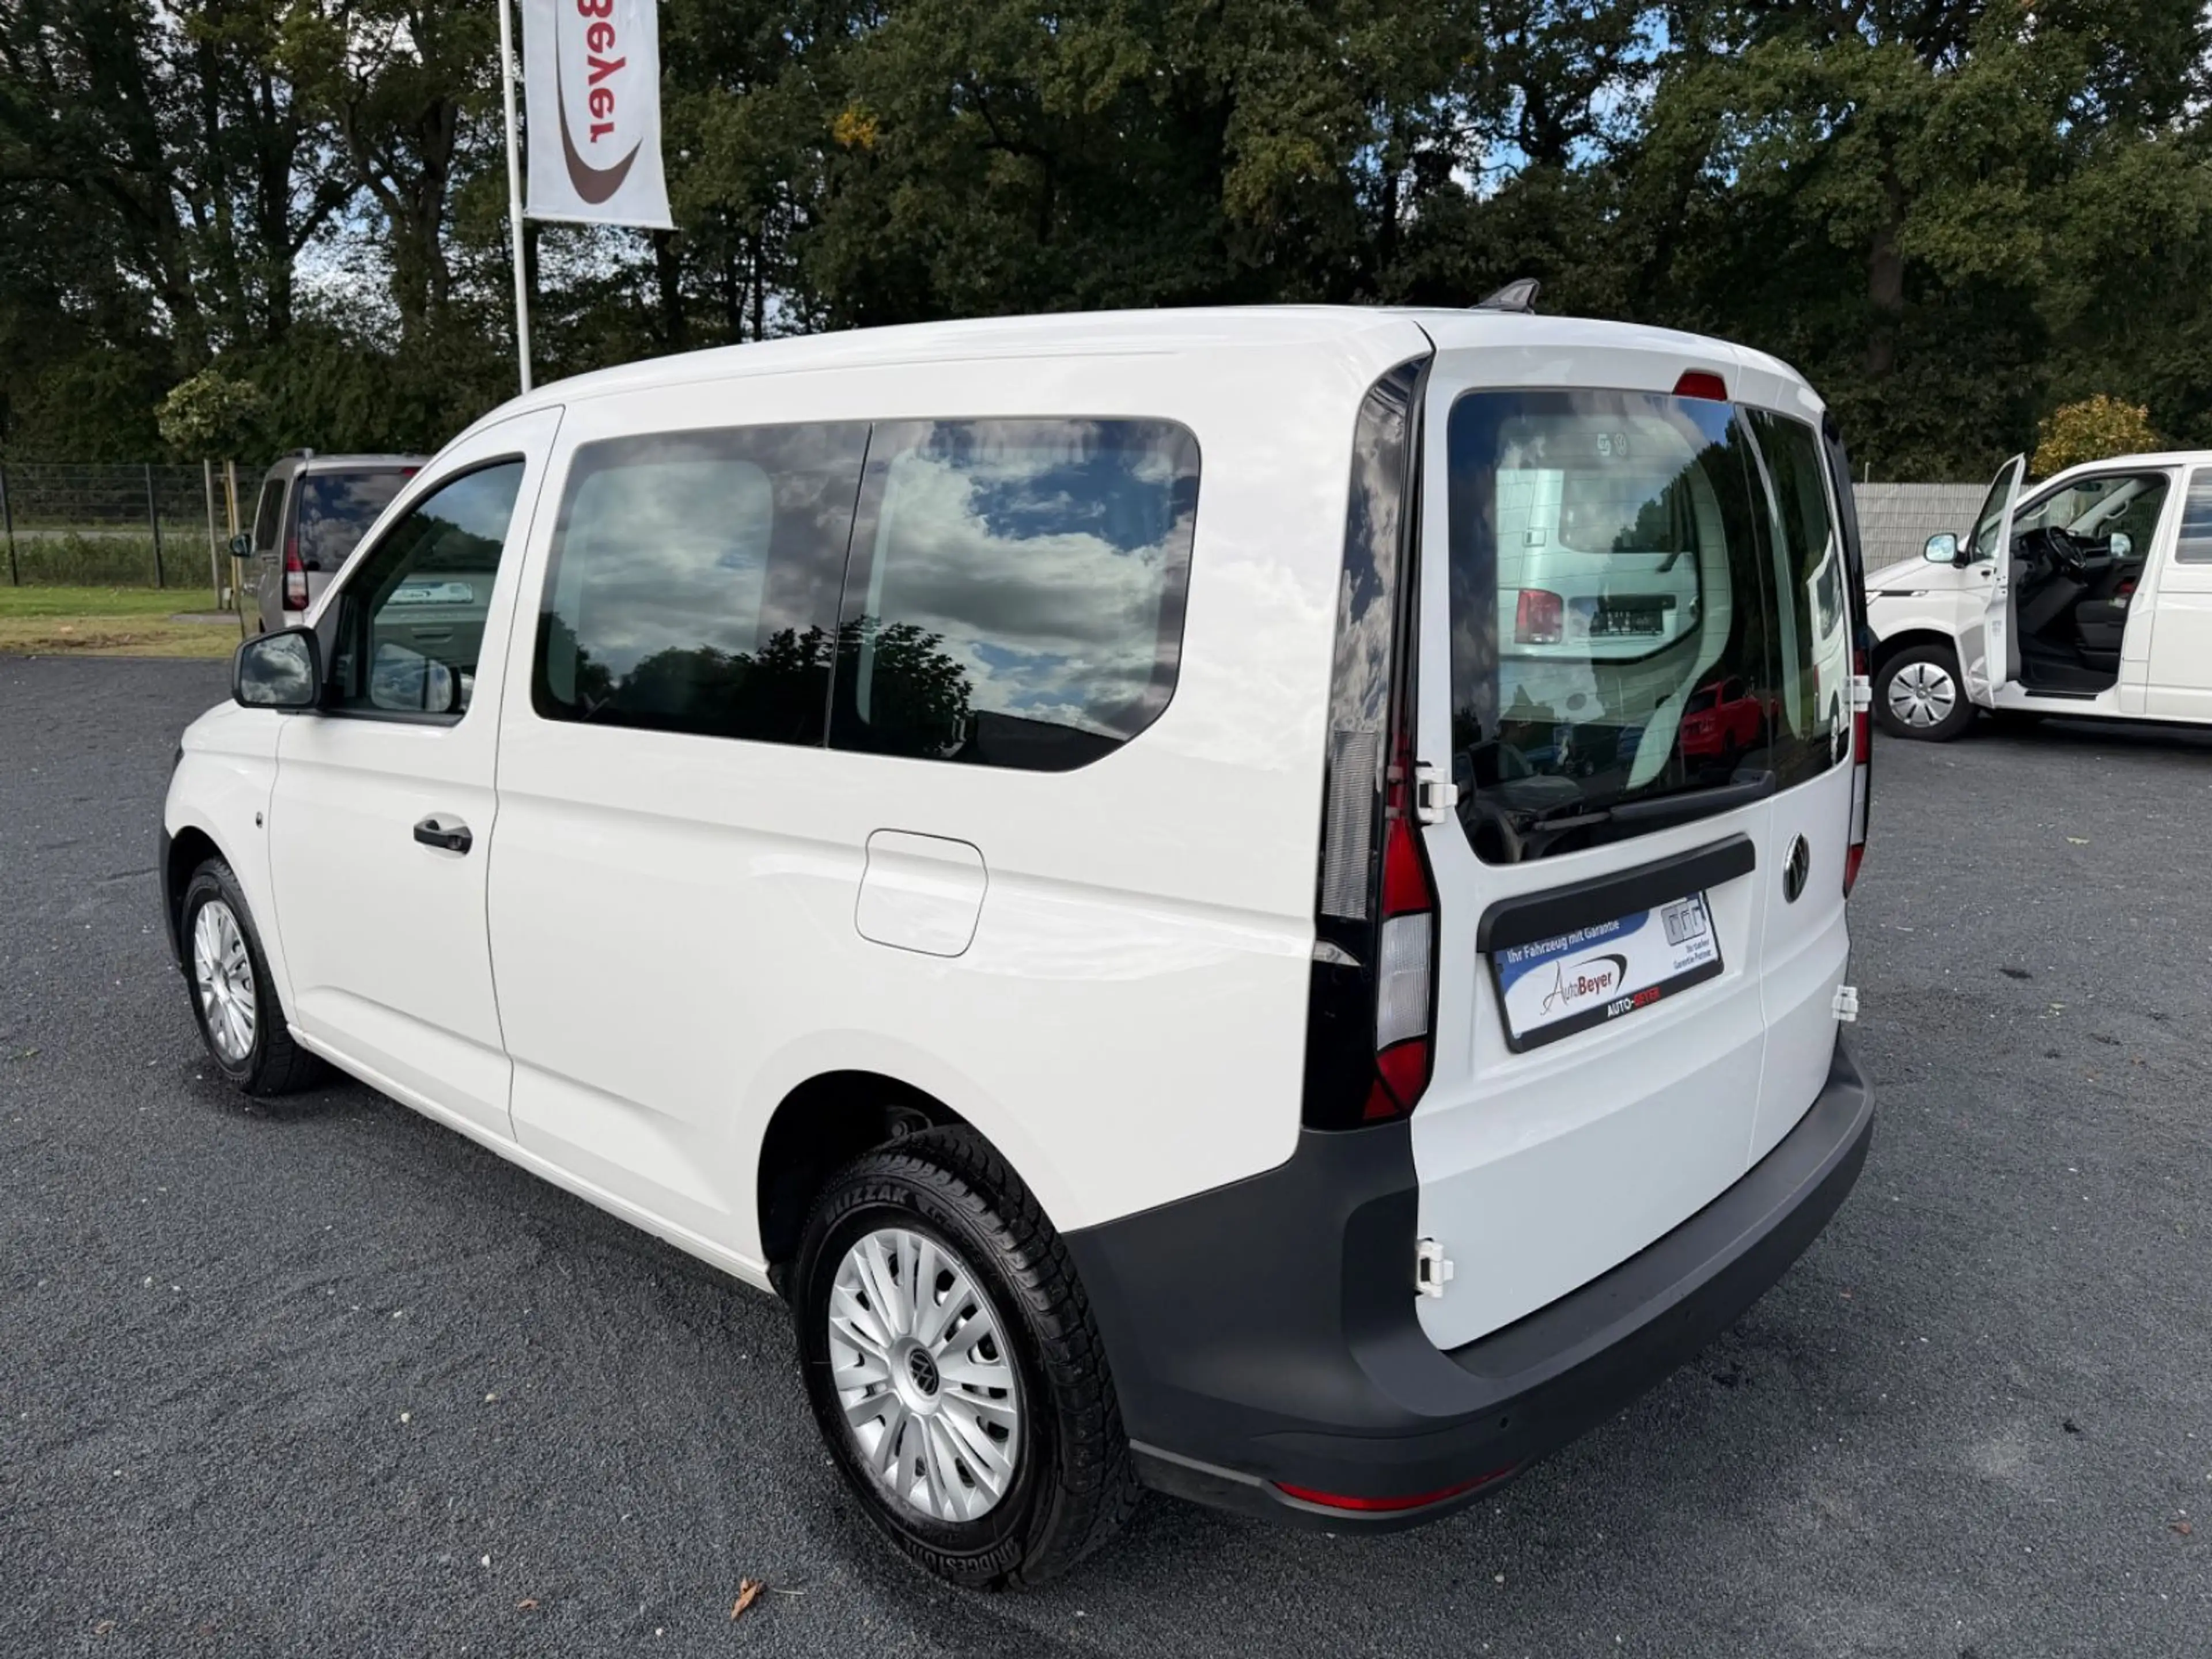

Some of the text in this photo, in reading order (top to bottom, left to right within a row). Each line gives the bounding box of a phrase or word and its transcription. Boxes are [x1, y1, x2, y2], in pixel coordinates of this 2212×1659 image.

[1506, 919, 1620, 964] Ihr Fahrzeug mit Garantie
[1607, 986, 1661, 1018] AUTO-BEYER
